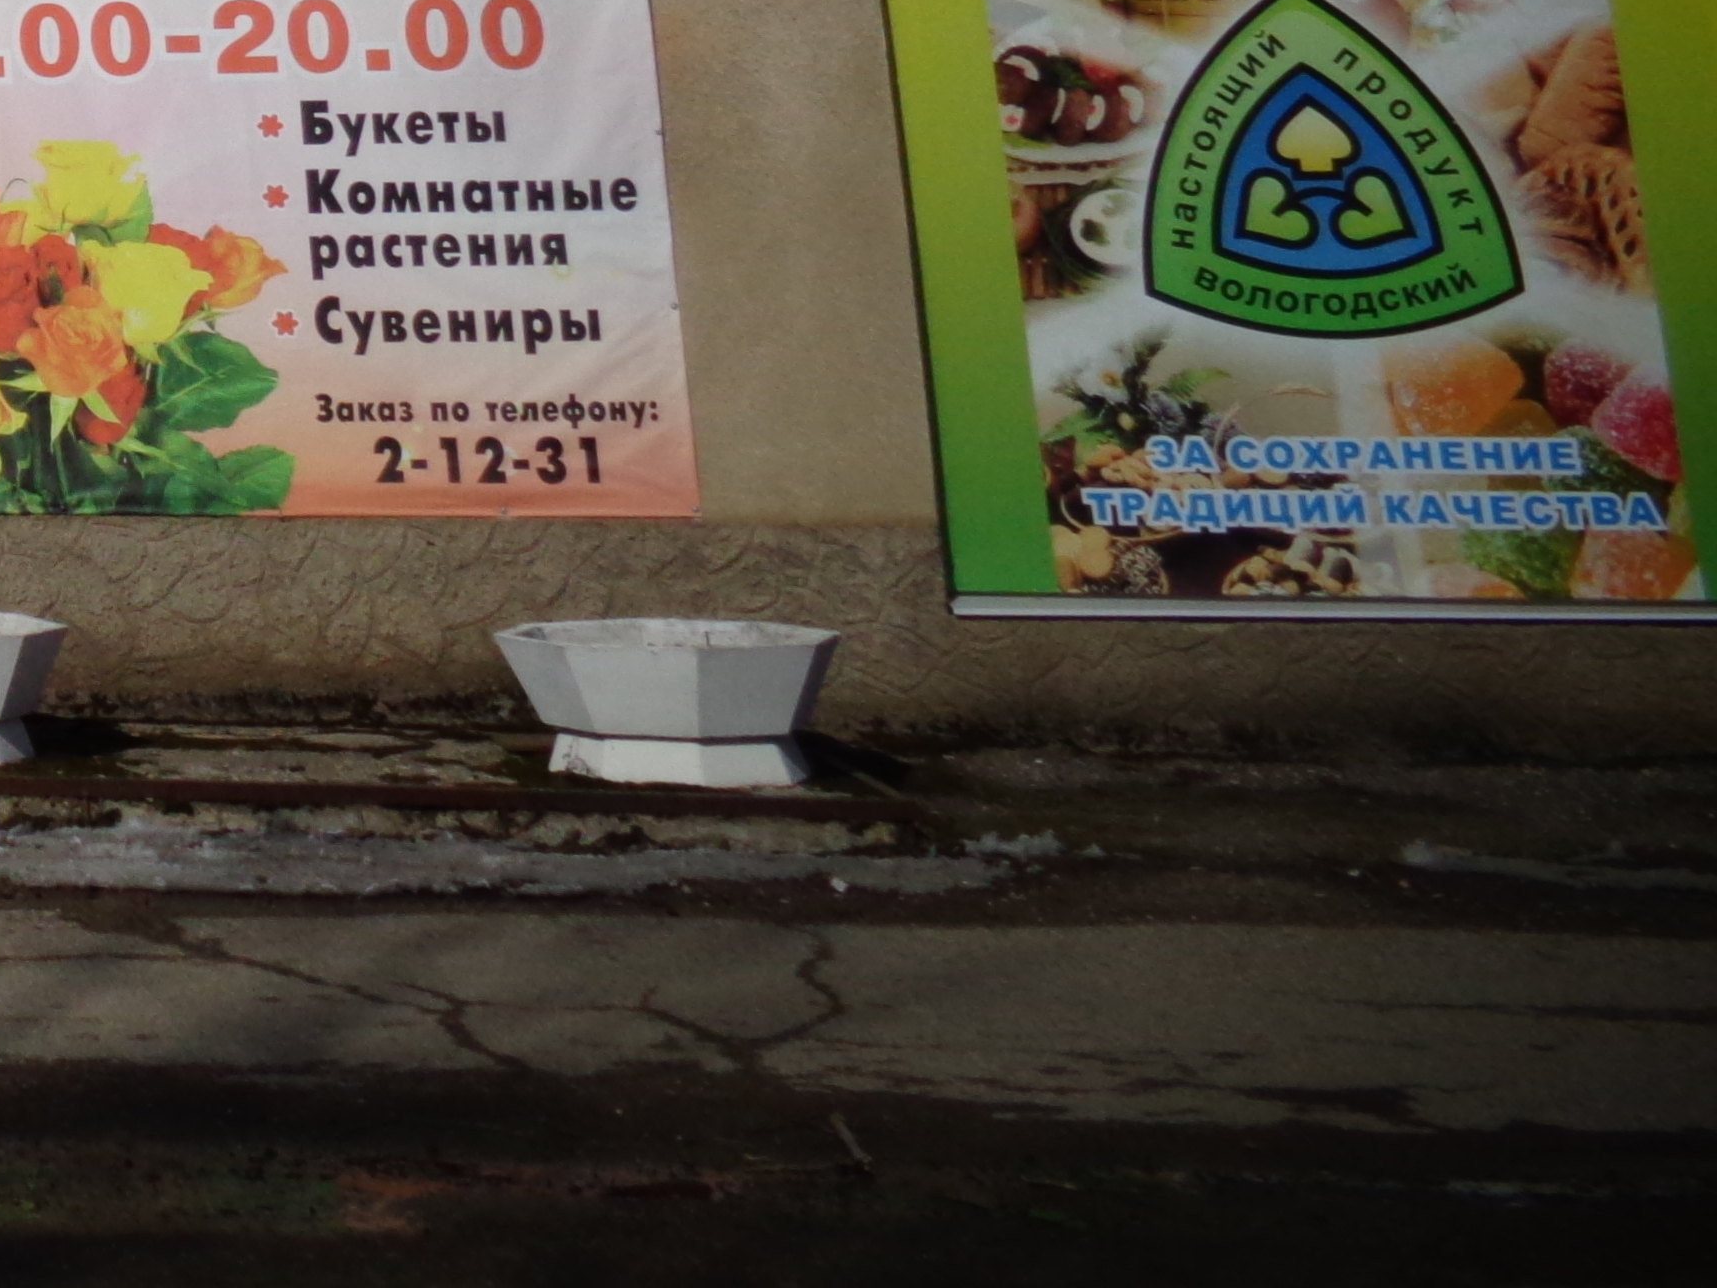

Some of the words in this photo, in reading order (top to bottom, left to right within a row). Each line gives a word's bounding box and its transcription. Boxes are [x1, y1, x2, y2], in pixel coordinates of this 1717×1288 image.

[300, 100, 507, 157] Букеты
[305, 168, 638, 215] Комнатные
[309, 232, 569, 281] растения
[314, 295, 602, 356] Сувениры
[315, 392, 414, 423] Заказ
[430, 400, 470, 423] по
[484, 392, 660, 430] телефону:
[373, 435, 602, 485] 2-12-31
[1149, 437, 1216, 471] ЗА
[1230, 438, 1579, 472] СОХРАНЕНИЕ
[1085, 486, 1366, 530] ТРАДИЦИЙ
[1384, 492, 1664, 530] КАЧЕСТВА
